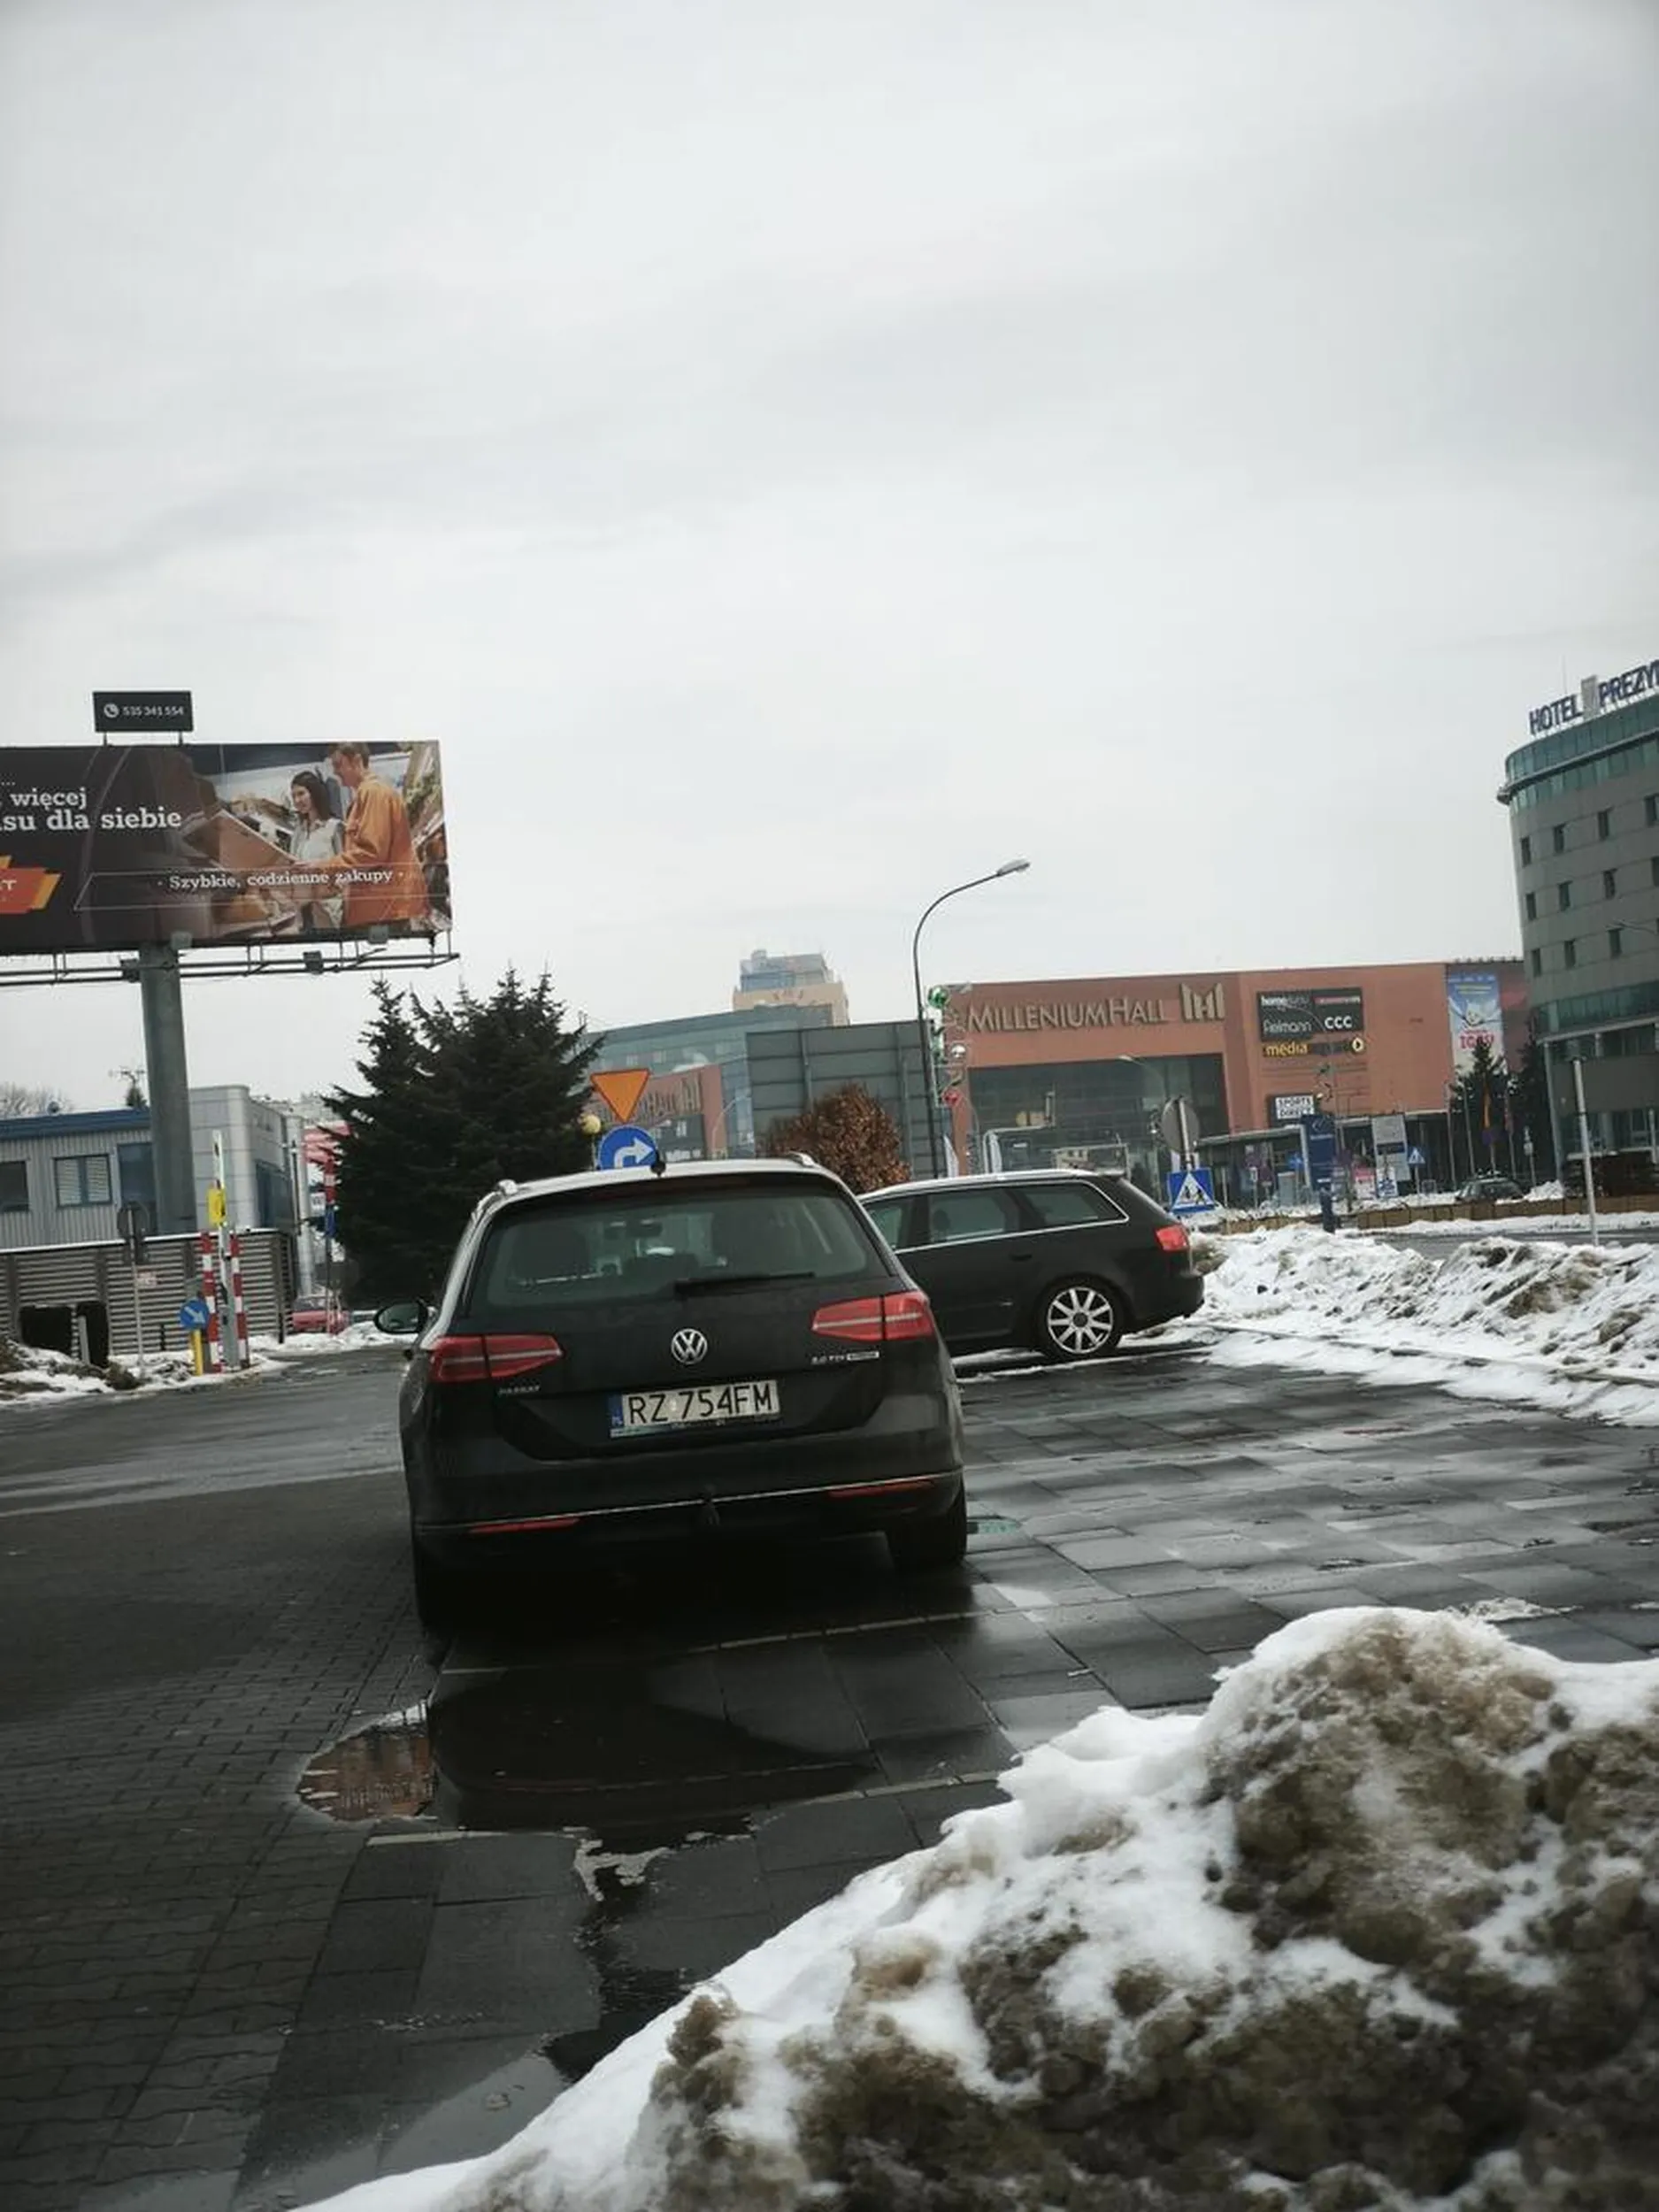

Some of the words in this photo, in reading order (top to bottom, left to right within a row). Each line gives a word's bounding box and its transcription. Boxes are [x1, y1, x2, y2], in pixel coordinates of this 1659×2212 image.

[1529, 695, 1582, 735] HOTEL
[10, 787, 87, 810] więcej
[0, 814, 36, 832] su
[46, 809, 89, 831] dla
[101, 806, 181, 829] siebie
[247, 871, 329, 887] codzienne
[334, 868, 394, 886] zakupy
[1325, 1016, 1352, 1029] CCC
[628, 1394, 668, 1424] RZ
[679, 1384, 772, 1419] 754FM
